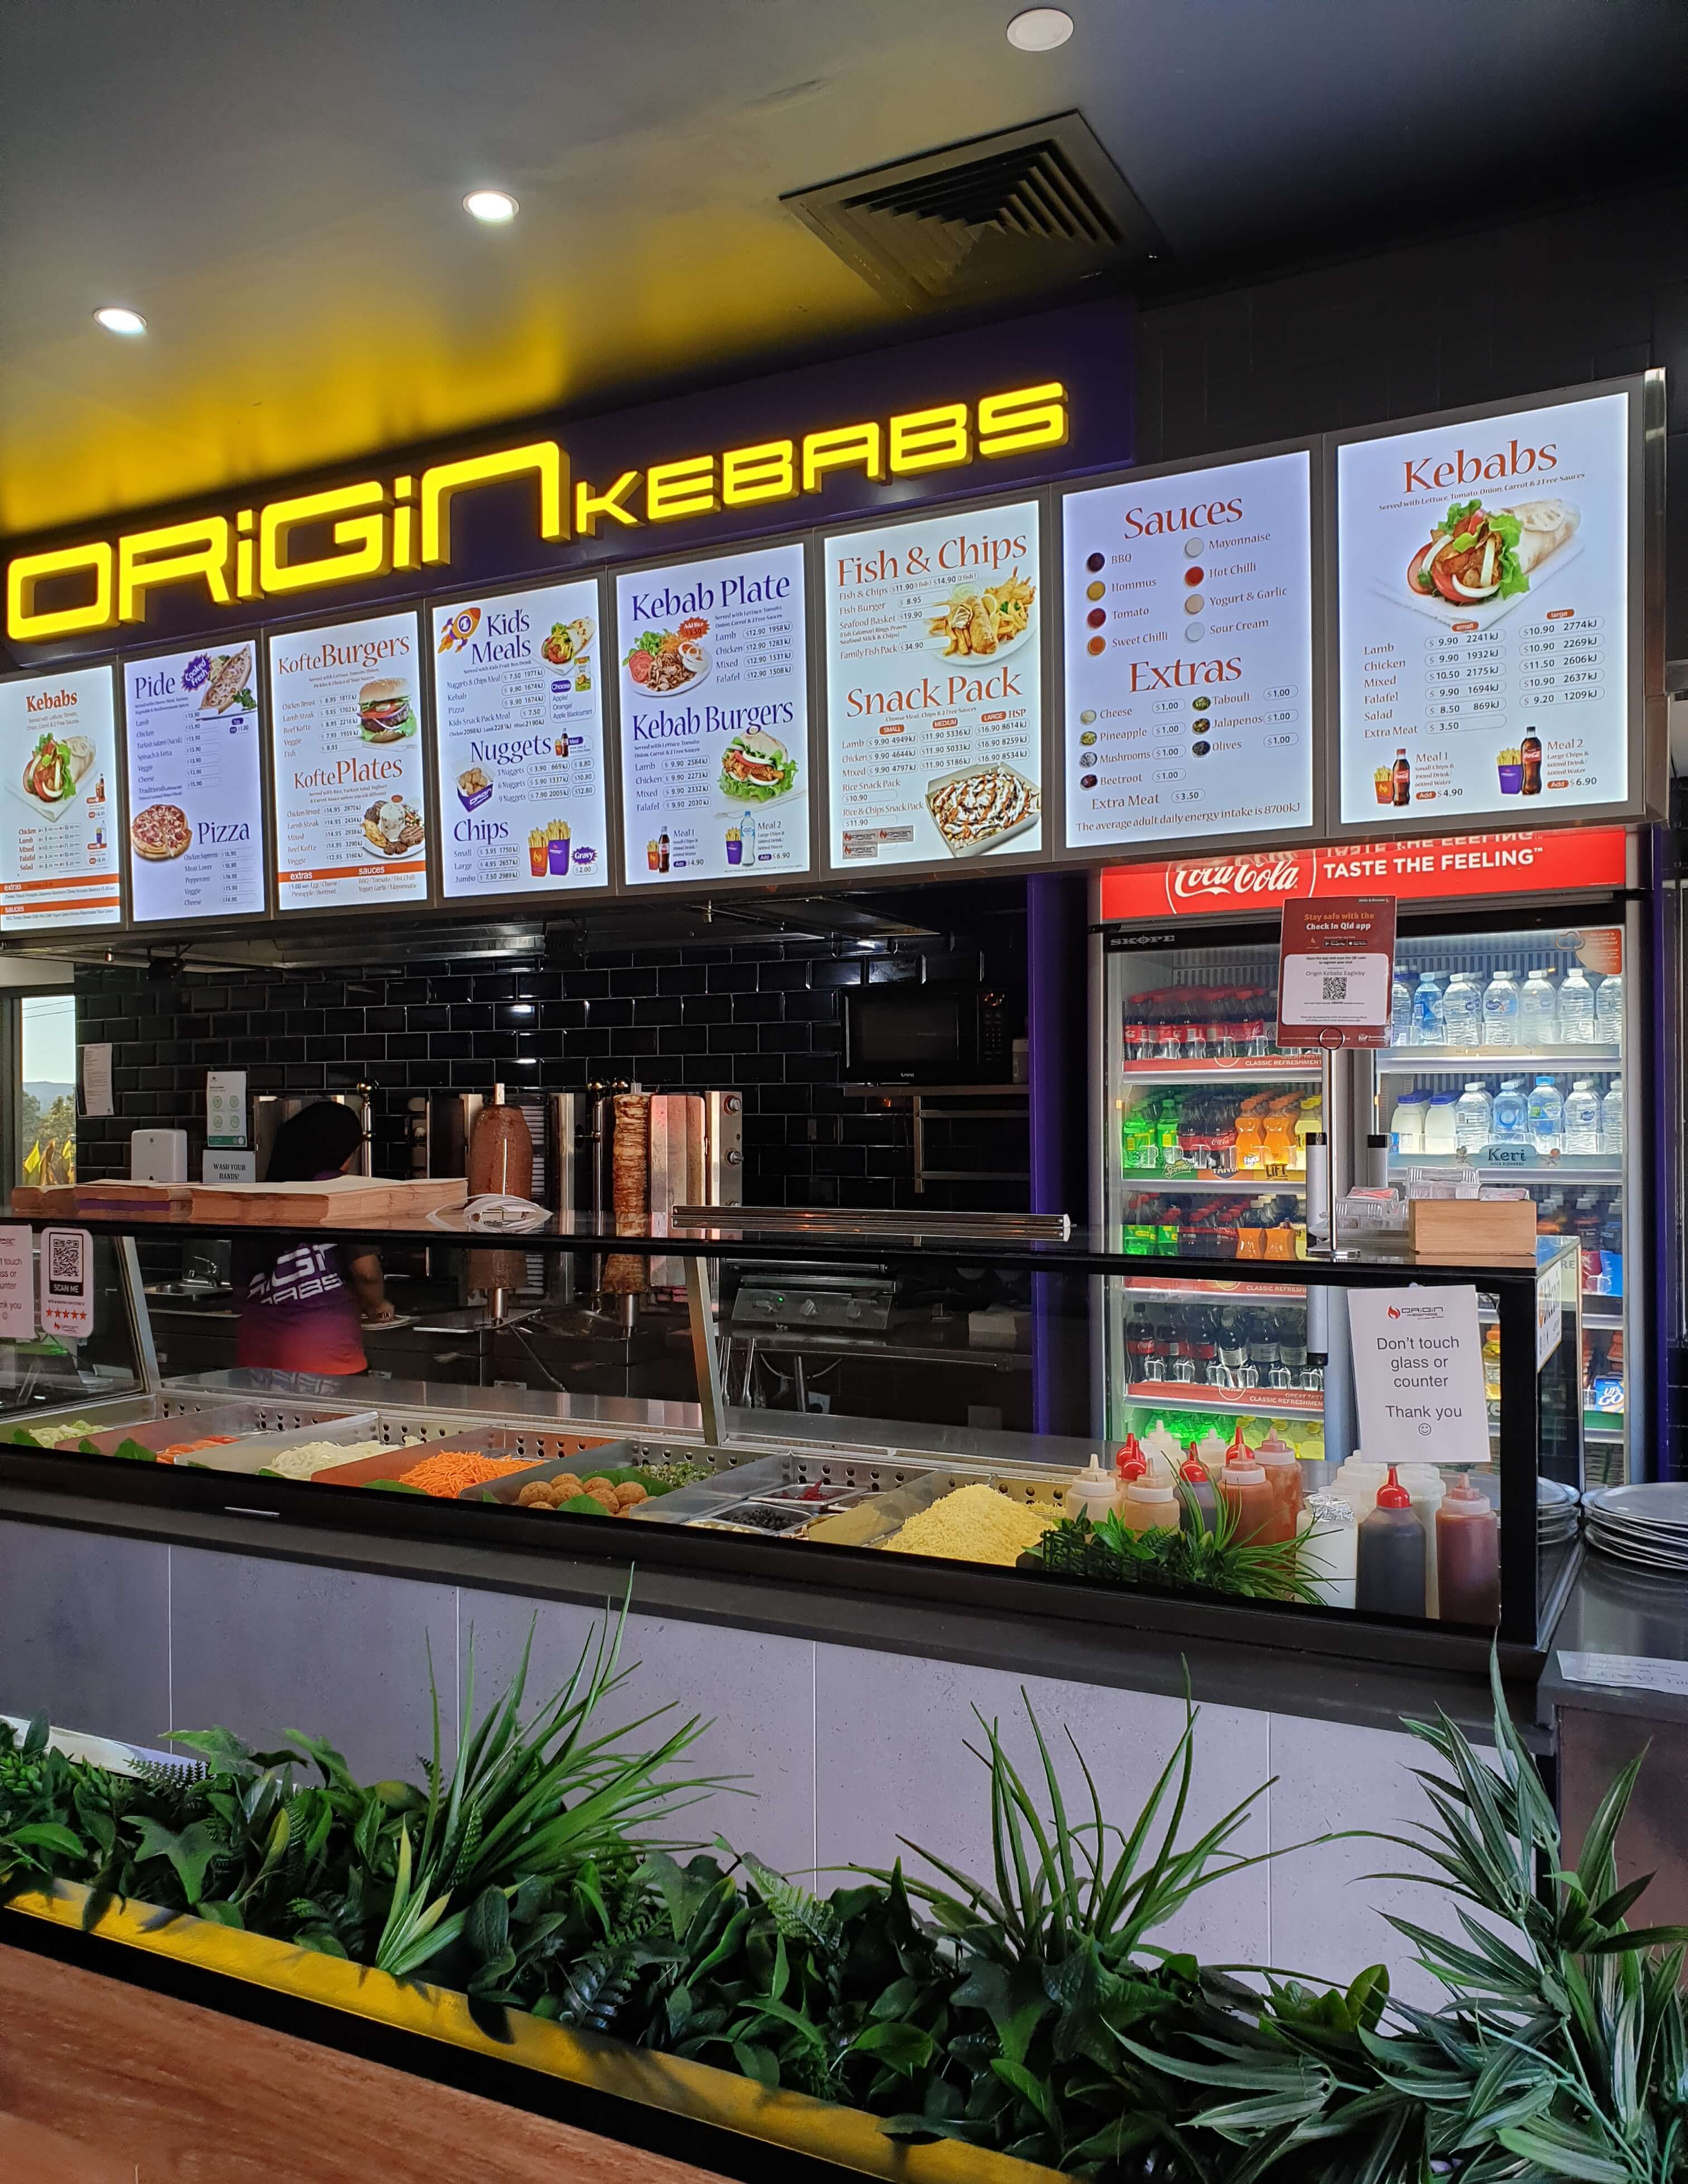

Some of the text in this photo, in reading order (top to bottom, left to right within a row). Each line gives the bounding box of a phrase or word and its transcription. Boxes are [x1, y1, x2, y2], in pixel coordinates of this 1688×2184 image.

[576, 382, 1066, 536] KEBABS
[1403, 439, 1557, 493] Kebabs
[1124, 497, 1243, 540] Sauces
[1209, 532, 1270, 550] Mayonnaise
[838, 535, 1027, 587] Fish & Chips
[1111, 554, 1131, 564] BBQ
[1210, 563, 1256, 578] Hot Chilli
[1112, 579, 1157, 592] Hommus
[632, 574, 790, 621] Kebab Plate
[1210, 587, 1287, 607] Yogurt & Garlic
[840, 601, 886, 615] Fish Burger
[1112, 607, 1149, 620] Tomato
[487, 608, 530, 637] Kid's
[840, 618, 869, 630] Seafood
[870, 615, 896, 626] Basket
[1210, 619, 1269, 634] Sour Cream
[716, 631, 736, 641] Lamb
[1112, 632, 1168, 648] Sweet Chilli
[471, 635, 531, 666] Meals
[716, 644, 743, 655] Chicken
[840, 645, 897, 660] Family Fish Pack
[1364, 643, 1394, 656] Lamb
[716, 659, 739, 669] Mixed
[1364, 658, 1406, 671] Chicken
[185, 659, 206, 683] Cooked
[1129, 656, 1243, 693] Extras
[191, 670, 208, 686] Fresh
[716, 673, 740, 683] Falafel
[1364, 676, 1397, 688] Mixed
[135, 672, 176, 699] Pide
[552, 681, 570, 692] Choose
[847, 666, 1023, 717] Snack Pack
[26, 690, 78, 712] Kebabs
[1212, 693, 1250, 705] Tabouli
[1364, 693, 1398, 705] Falafel
[934, 719, 956, 727] MEDIUM
[1009, 709, 1026, 718] HSP
[1100, 707, 1133, 719] Cheese
[1364, 710, 1393, 721] Salad
[632, 702, 793, 740] Kebab Burgers
[1212, 716, 1263, 729] Jalapenos
[1100, 728, 1147, 742] Pineapple
[1364, 726, 1418, 738] Extra Meat
[470, 735, 552, 765] Nuggets
[1212, 741, 1242, 751] Olives
[1547, 739, 1584, 750] Meal 2
[842, 753, 867, 763] Chicken
[1100, 751, 1150, 764] Mushrooms
[842, 767, 866, 777] Mixed
[843, 779, 900, 791] Rice Snack Pack
[1100, 774, 1142, 786] Beetroot
[1092, 794, 1160, 810] Extra Meat
[1076, 803, 1300, 832] The average adult daily energy intake is 8700kJ
[454, 819, 509, 844] Chips
[758, 821, 775, 831] Meal
[198, 823, 250, 844] Pizza
[454, 849, 472, 858] Small
[574, 851, 594, 861] Gravy
[358, 866, 385, 875] sauces
[454, 862, 473, 871] Large
[1323, 860, 1387, 879] TASTE
[1393, 856, 1434, 873] THE
[455, 874, 476, 883] Jumbo
[1488, 1149, 1527, 1161] Keri
[1266, 1164, 1287, 1177] LIFT
[1377, 1336, 1459, 1350] Don't touch
[1391, 1357, 1449, 1371] glass or
[1394, 1375, 1449, 1387] counter
[1599, 1394, 1624, 1405] GO
[1385, 1405, 1462, 1420] Thank you
